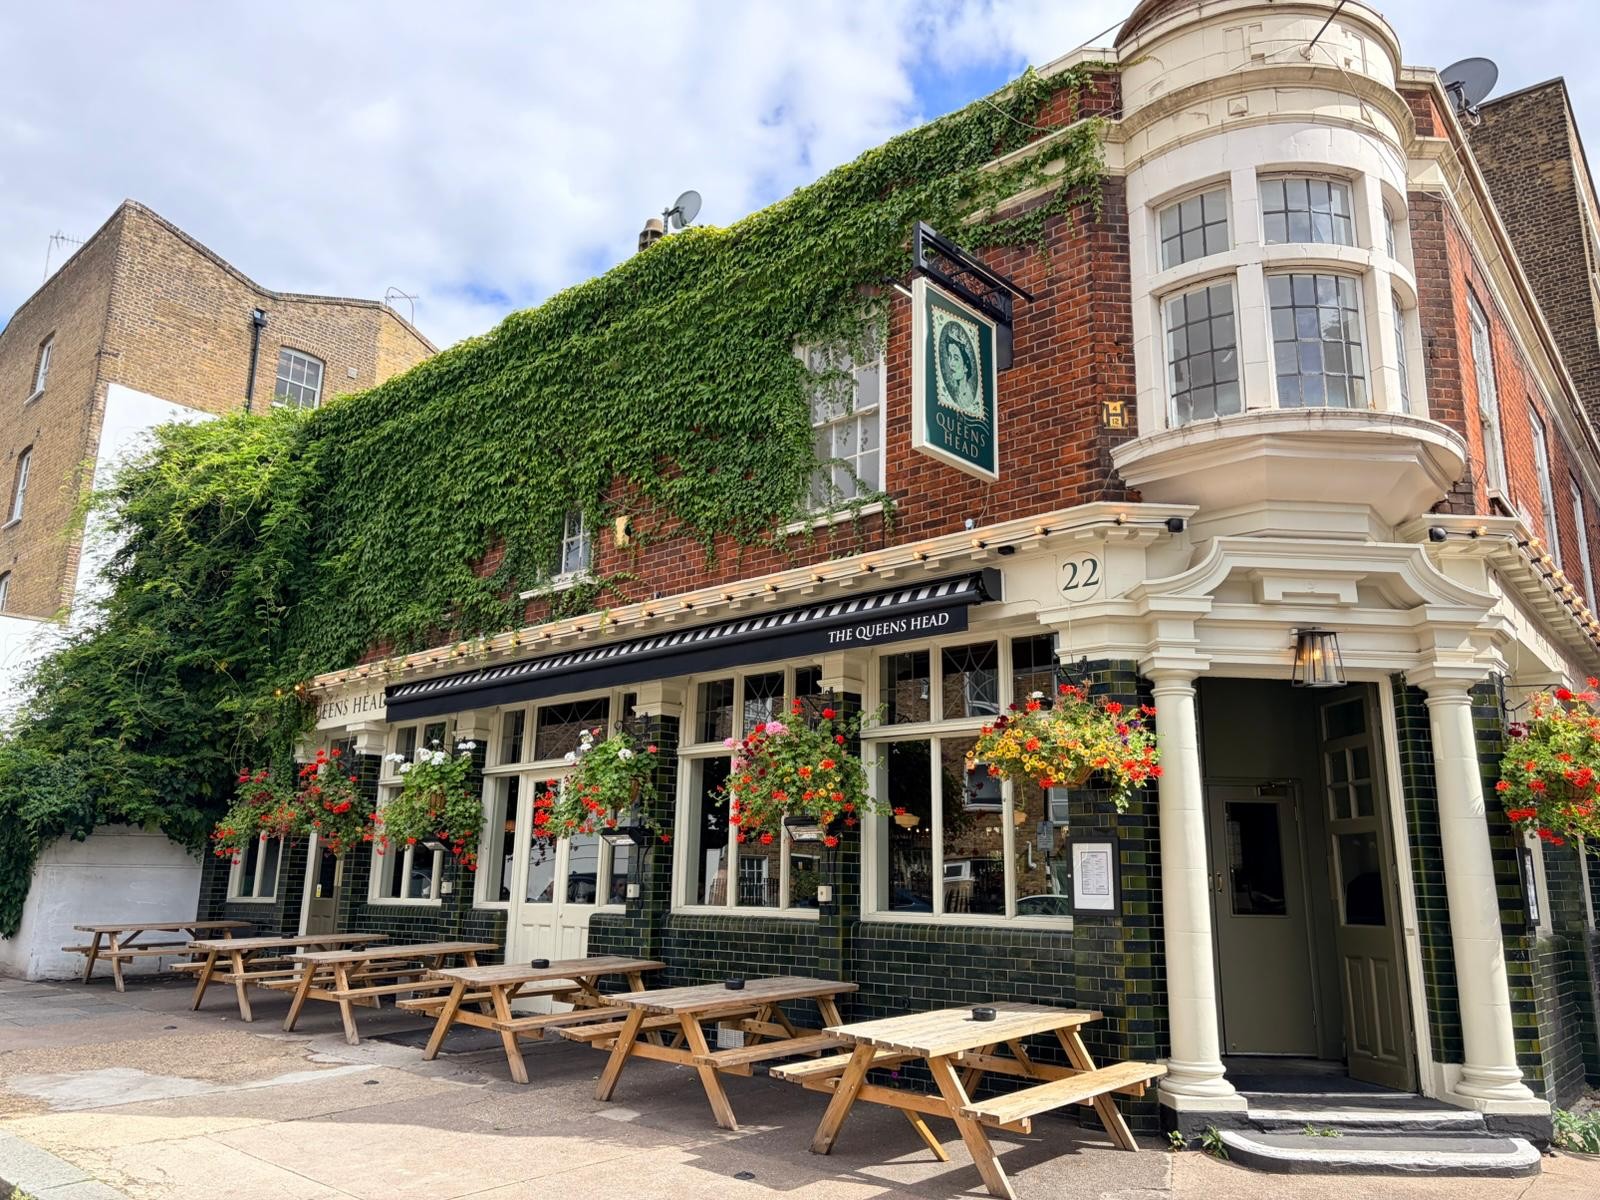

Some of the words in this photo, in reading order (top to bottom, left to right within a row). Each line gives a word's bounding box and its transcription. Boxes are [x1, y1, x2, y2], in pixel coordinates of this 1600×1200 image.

[936, 412, 986, 447] QUEENS
[1111, 417, 1120, 425] 12
[944, 431, 979, 458] HEAD
[1062, 558, 1100, 591] 22
[828, 628, 853, 644] THE
[856, 619, 907, 640] QUEENS
[910, 612, 949, 630] HEAD
[353, 692, 386, 714] HEAD
